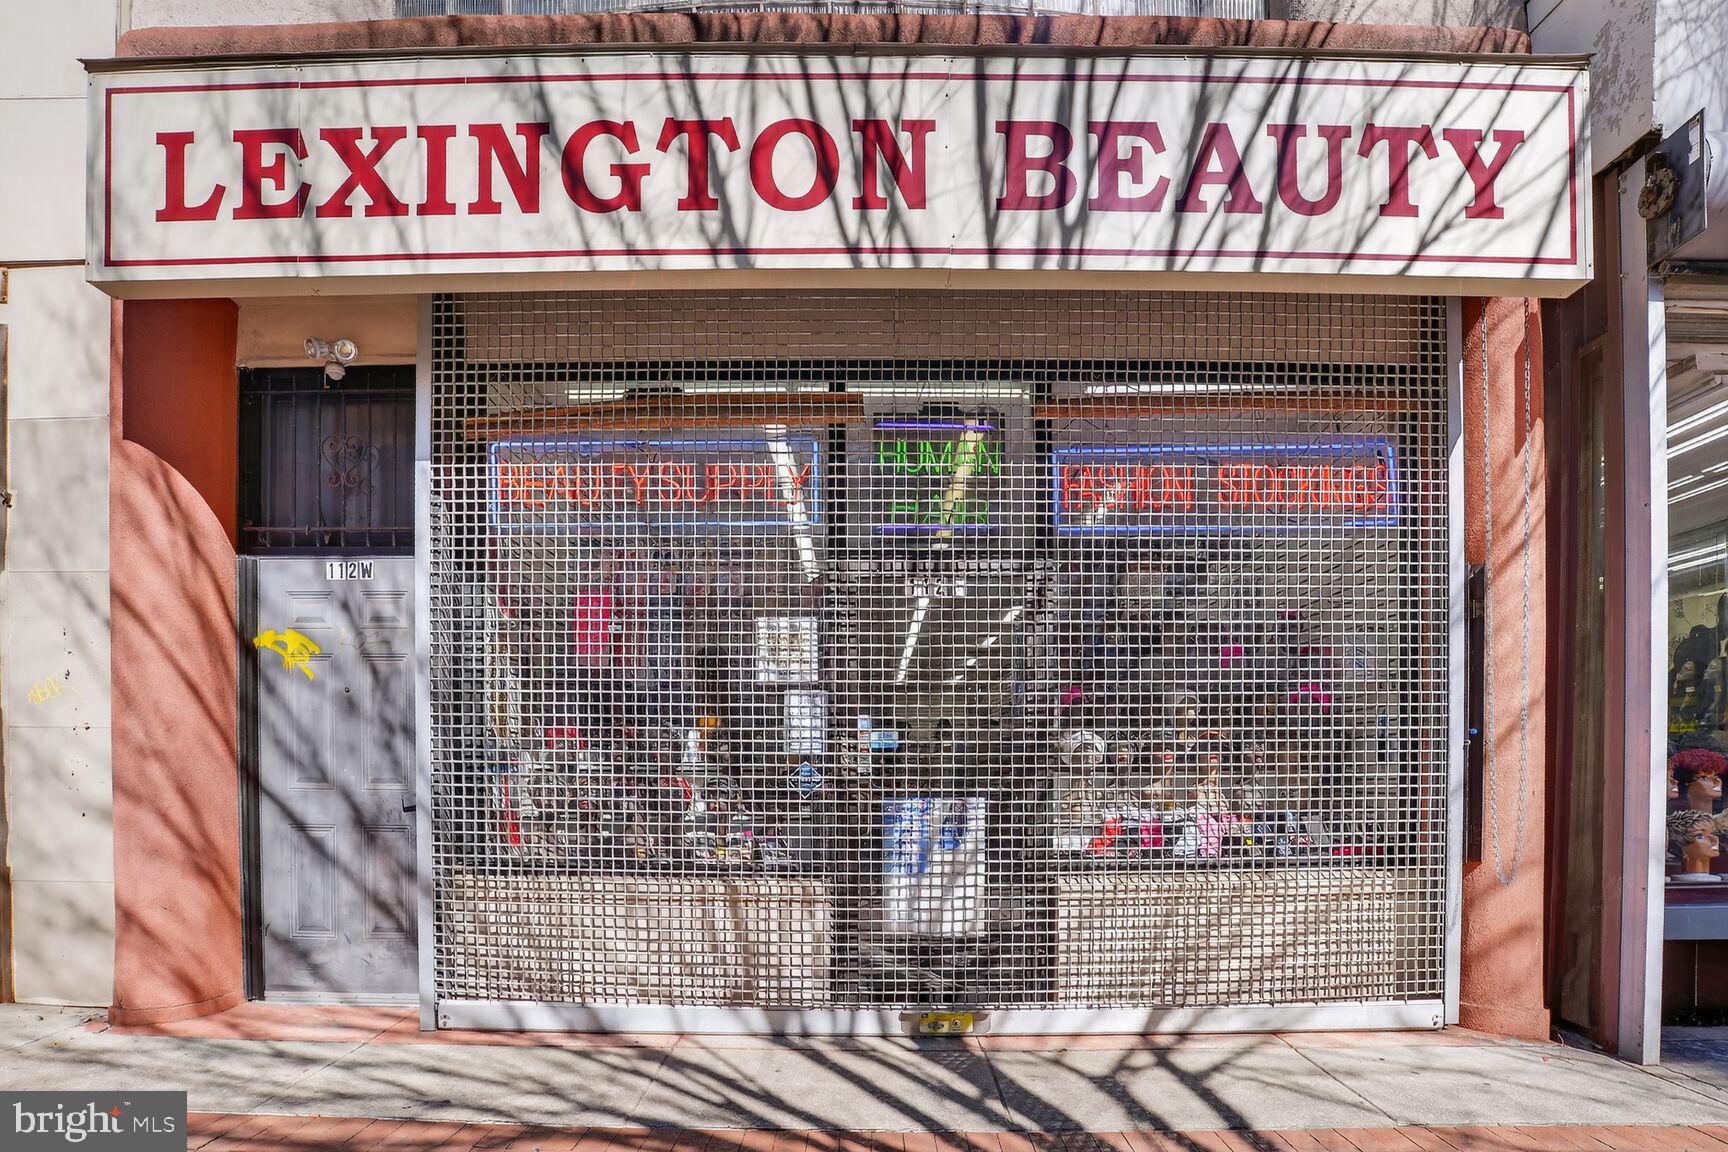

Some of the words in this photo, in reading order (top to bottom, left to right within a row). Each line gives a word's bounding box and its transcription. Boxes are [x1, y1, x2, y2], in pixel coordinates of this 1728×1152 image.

[155, 118, 936, 222] LEXINGTON
[995, 120, 1525, 220] BEAUTY
[879, 439, 999, 474] HUMAN
